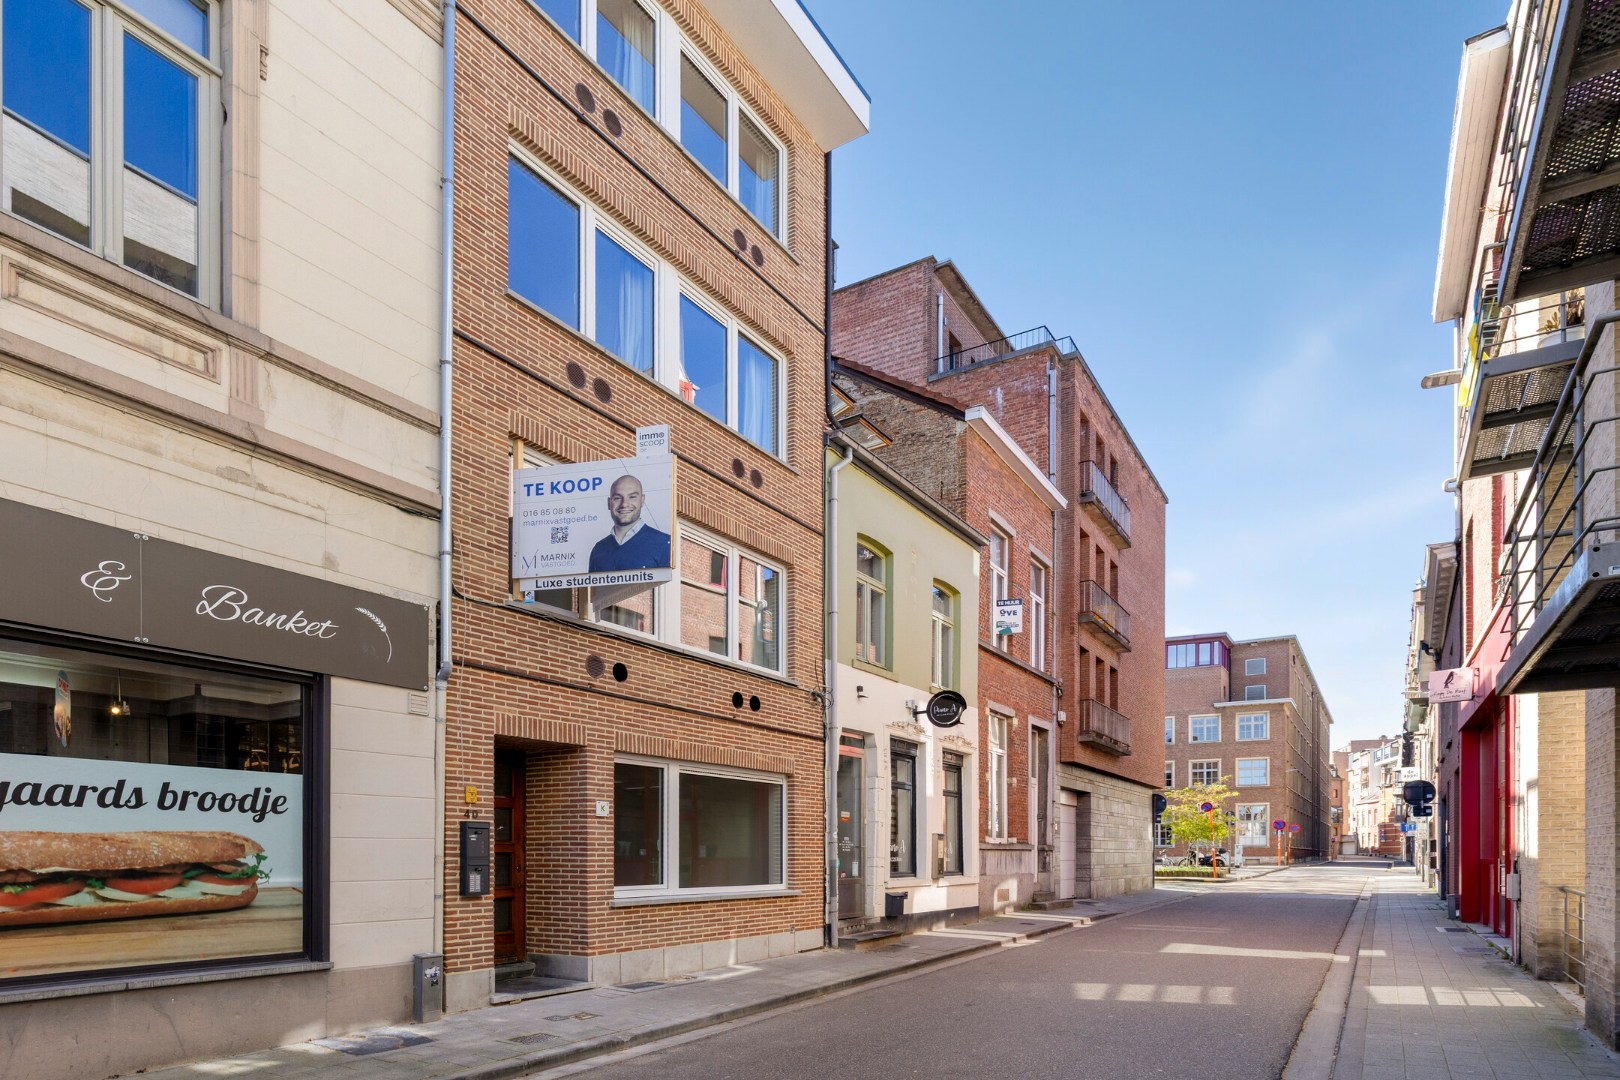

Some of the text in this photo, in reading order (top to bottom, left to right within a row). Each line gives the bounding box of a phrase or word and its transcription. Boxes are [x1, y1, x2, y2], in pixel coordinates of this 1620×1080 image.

[639, 431, 665, 441] immo
[639, 439, 665, 448] scoop
[523, 477, 603, 497] TE KOOP
[522, 510, 539, 518] 016
[552, 507, 564, 515] 08
[565, 506, 576, 514] 80
[522, 514, 598, 527] marnixvastgoed.be
[540, 552, 576, 562] MARNIX
[540, 560, 576, 568] VASTGOED
[535, 571, 654, 589] Luxe studentenunits
[80, 559, 340, 640] & Banket
[157, 781, 289, 823] broodje
[463, 809, 479, 819] 40
